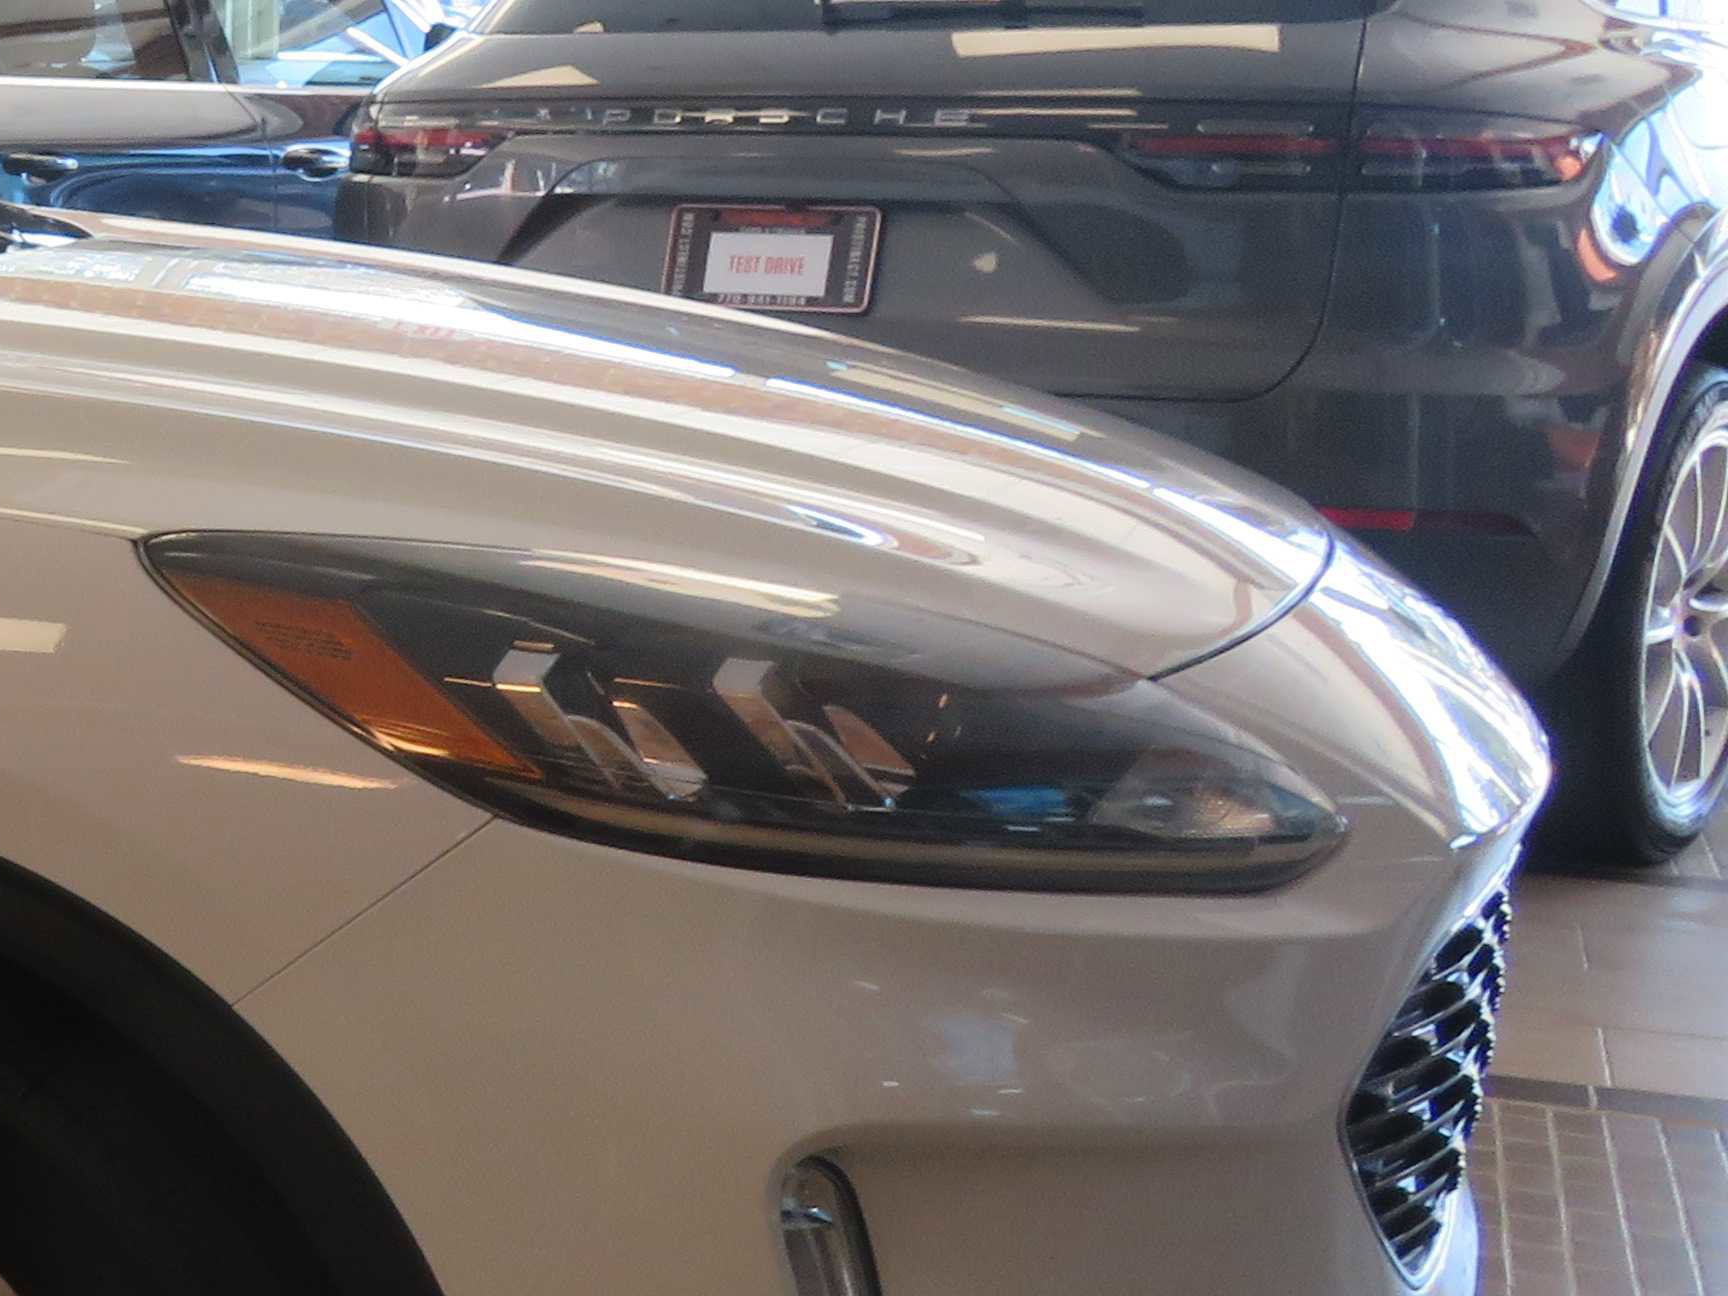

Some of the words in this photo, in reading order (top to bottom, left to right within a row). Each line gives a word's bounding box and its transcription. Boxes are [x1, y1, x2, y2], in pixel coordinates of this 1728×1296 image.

[601, 107, 970, 126] PORSCHE
[728, 255, 762, 274] TEST
[764, 255, 807, 275] DRIVE
